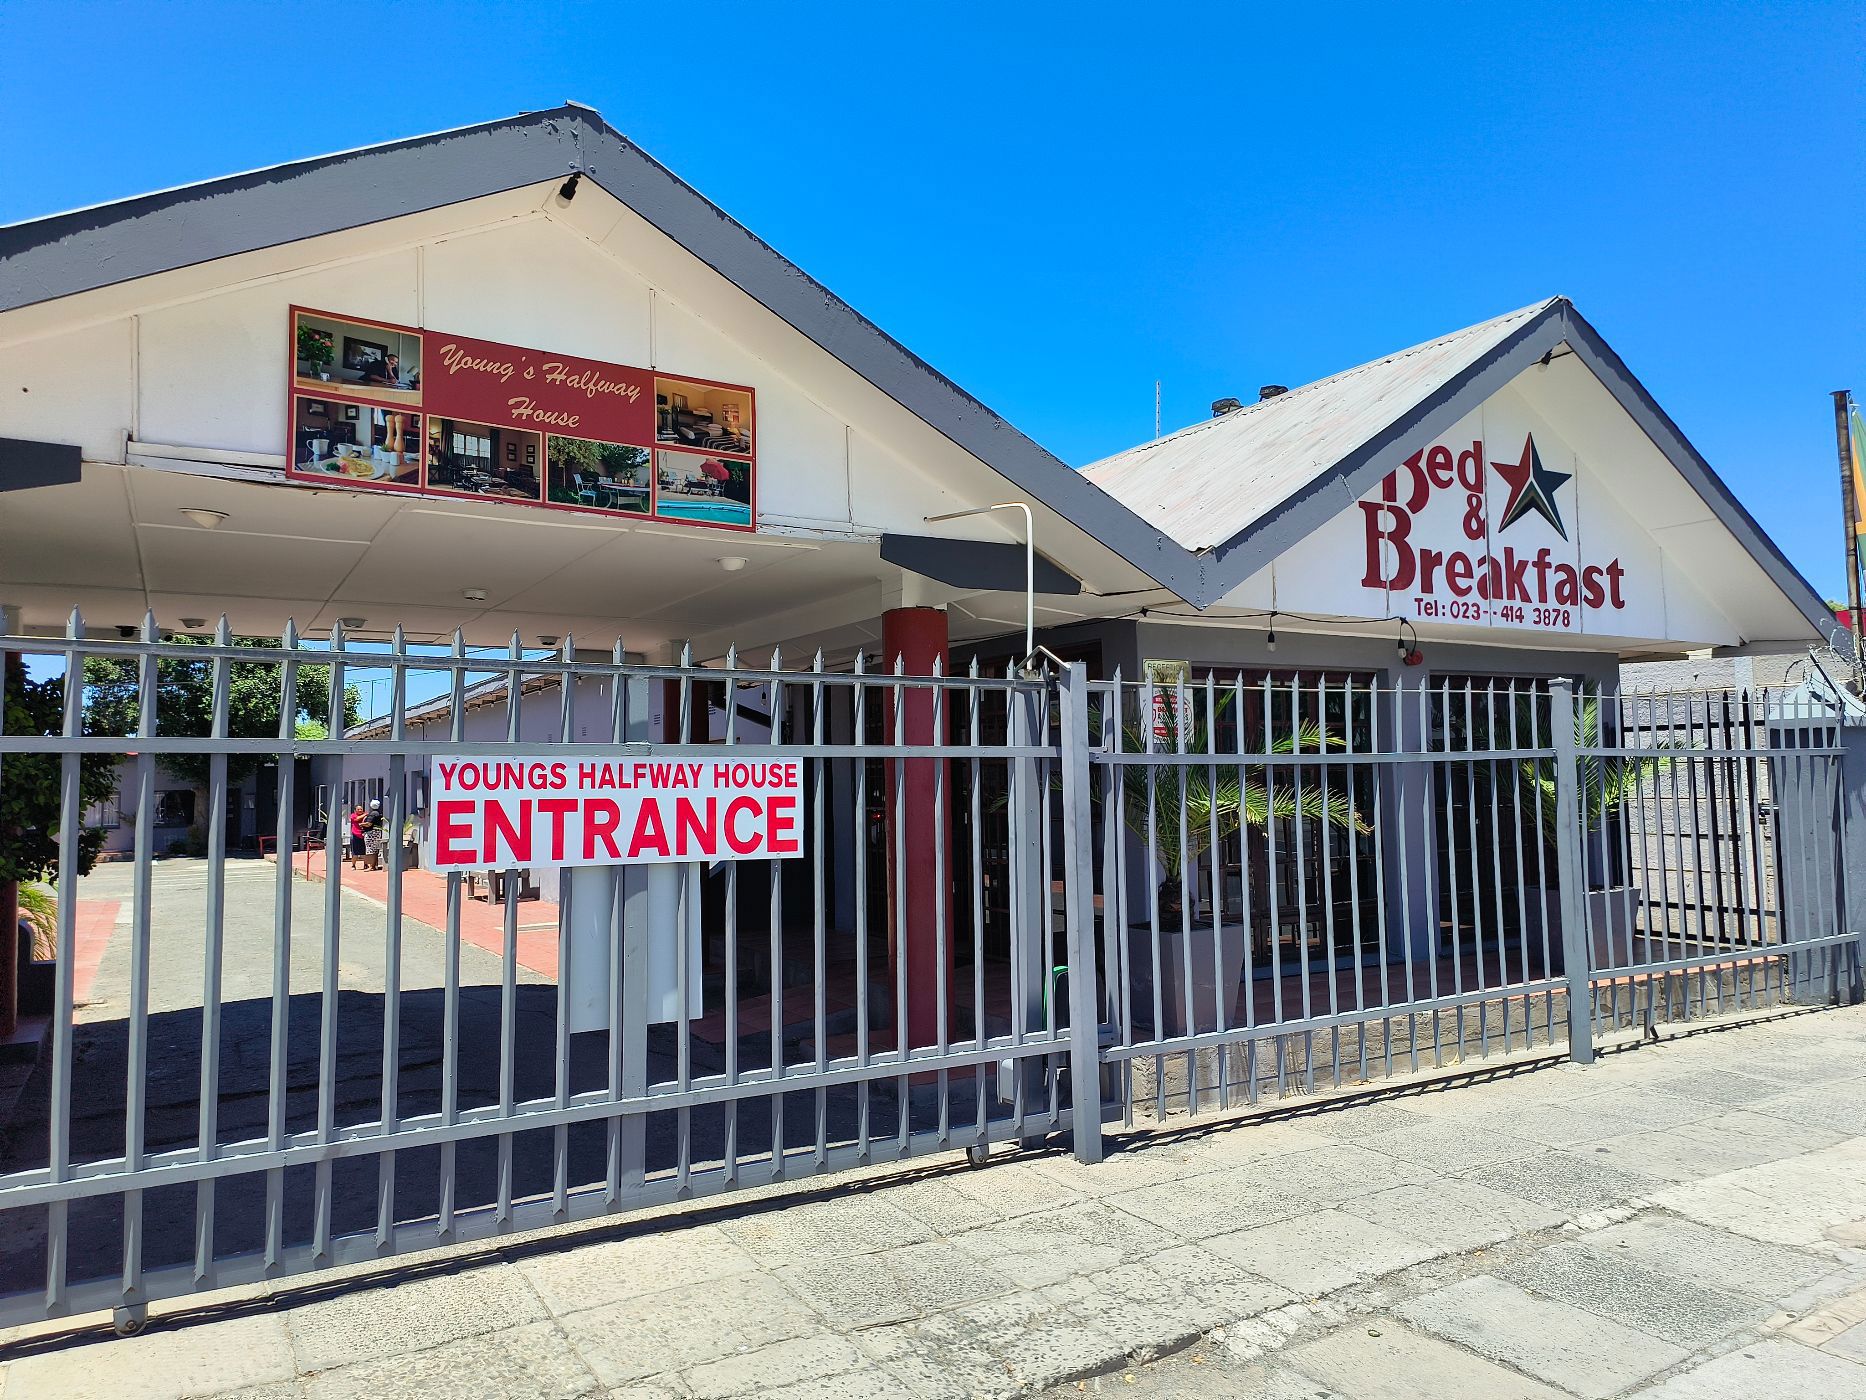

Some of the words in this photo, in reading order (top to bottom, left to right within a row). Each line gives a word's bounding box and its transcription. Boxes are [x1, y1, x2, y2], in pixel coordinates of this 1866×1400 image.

[439, 343, 536, 383] Young's
[542, 362, 642, 404] Halfway
[508, 396, 580, 428] House
[1382, 440, 1484, 515] Bed
[1462, 493, 1486, 541] &
[1358, 500, 1626, 610] Breakfast
[1414, 597, 1446, 617] Tel:
[1532, 607, 1571, 628] 3878
[438, 762, 568, 791] YOUNGS
[578, 763, 704, 790] HALFWAY
[713, 763, 799, 789] HOUSE
[436, 795, 799, 866] ENTRANCE
